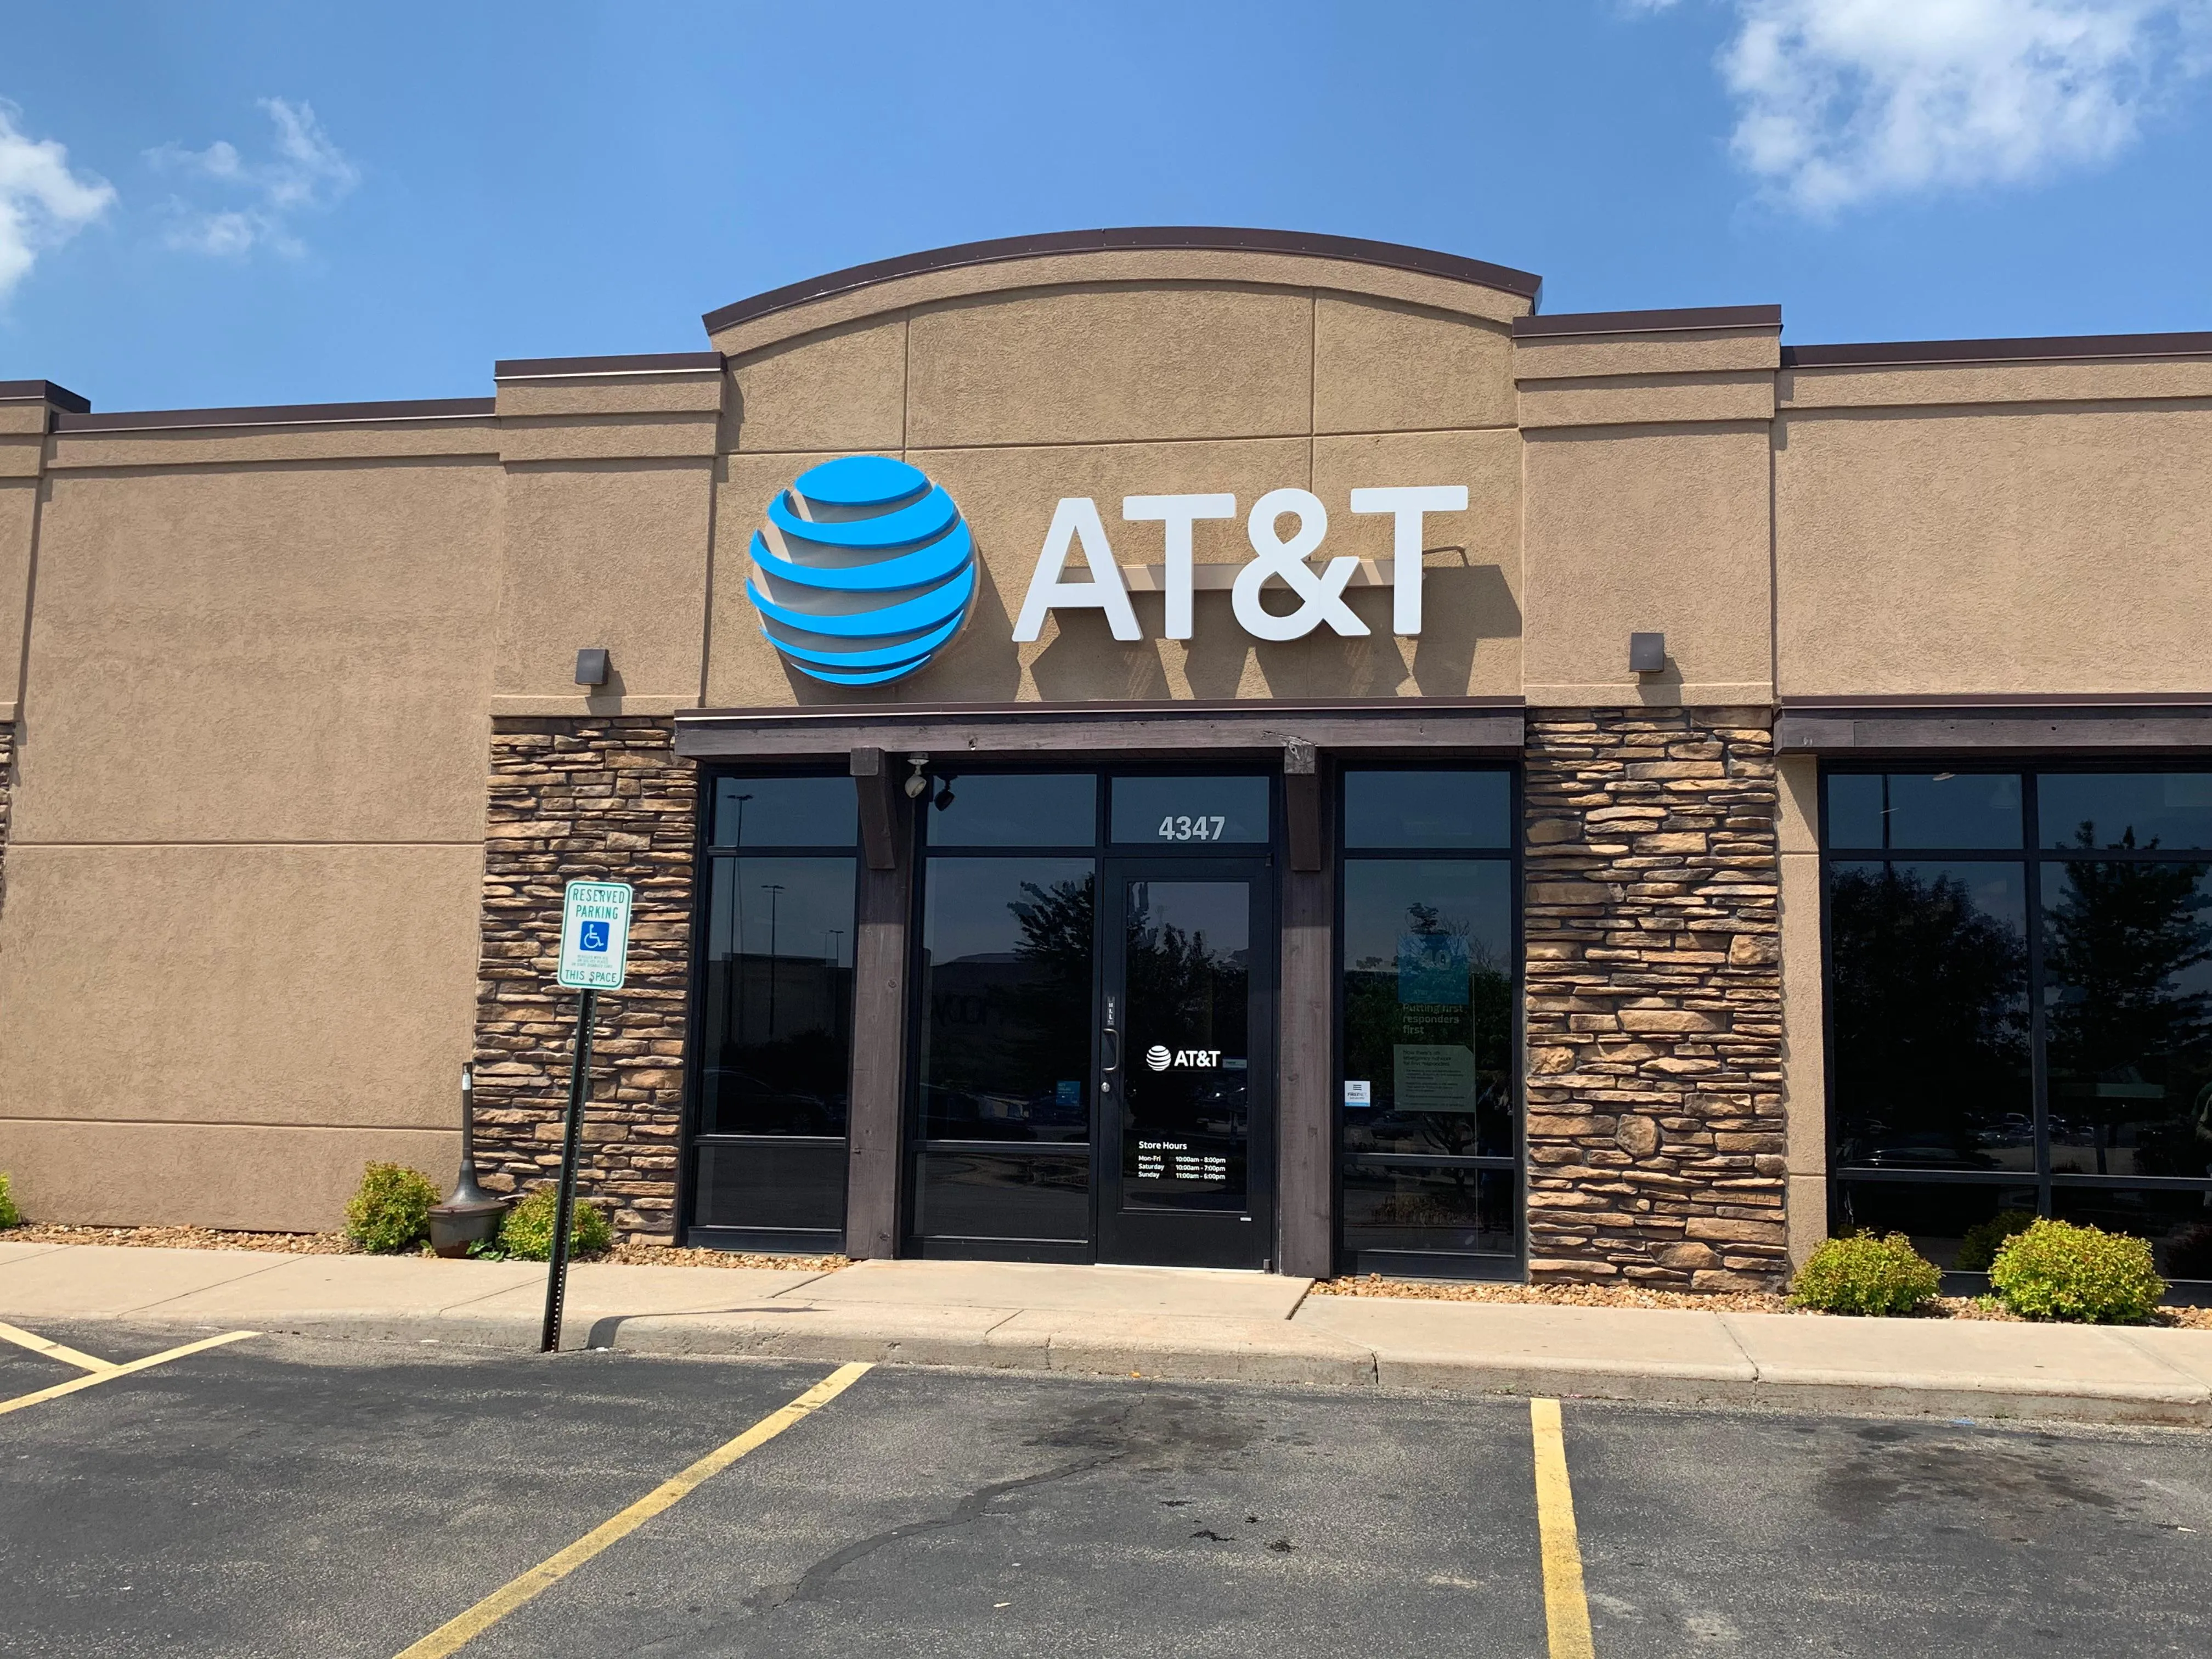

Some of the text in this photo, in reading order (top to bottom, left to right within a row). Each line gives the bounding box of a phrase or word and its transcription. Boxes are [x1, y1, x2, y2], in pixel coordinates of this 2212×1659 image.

[1012, 485, 1469, 641] AT&T
[1158, 816, 1225, 840] 4347
[573, 888, 625, 904] RESERVED
[576, 905, 619, 919] PARKING
[565, 969, 617, 983] THIS SPACE
[1402, 1003, 1440, 1014] Putting
[1402, 1014, 1460, 1024] responders
[1402, 1025, 1425, 1035] first
[1174, 1050, 1221, 1067] AT&T
[1138, 1141, 1187, 1150] Store Hours
[1138, 1163, 1165, 1171] Saturday
